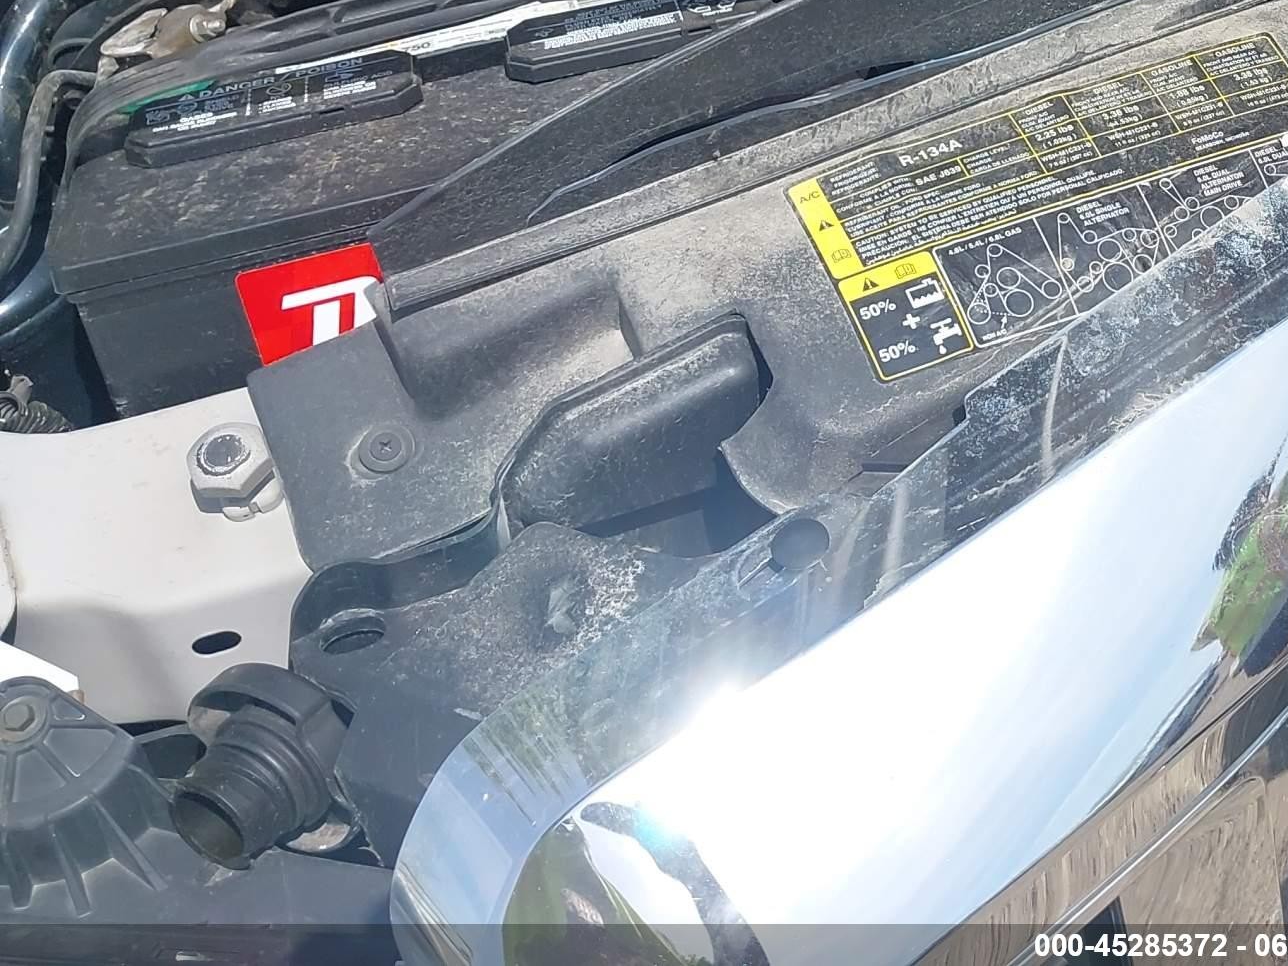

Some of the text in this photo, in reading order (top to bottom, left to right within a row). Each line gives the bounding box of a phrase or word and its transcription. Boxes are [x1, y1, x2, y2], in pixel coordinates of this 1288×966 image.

[1215, 42, 1254, 56] GASOLINE
[1151, 59, 1192, 76] GASOLINE
[1252, 67, 1268, 75] lbs
[199, 76, 274, 97] DANGER
[295, 58, 362, 76] POISON
[1093, 82, 1123, 94] DIESEL
[1189, 85, 1204, 93] lbs
[1025, 101, 1052, 115] DIESEL
[1122, 105, 1139, 113] lbs
[1035, 124, 1073, 140] 2.25 lbs
[1191, 131, 1223, 144] FoMoCo
[898, 139, 961, 165] R-134A
[1254, 146, 1277, 157] DIESEL
[915, 165, 961, 185] SAE J639
[1193, 164, 1217, 175] DIESEL
[1196, 169, 1229, 182] 6.0L DUAL
[1201, 171, 1243, 189] ALTERNATOR
[1203, 180, 1242, 196] MAIN DRIVE
[796, 190, 821, 203] A/C
[844, 208, 888, 226] REFRIGERANT
[905, 196, 922, 204] FORD
[889, 221, 916, 234] SYSTEM
[939, 203, 971, 217] SERVICED
[982, 188, 1016, 202] QUALIFIED
[921, 224, 950, 236] SISTEMA
[951, 217, 969, 227] DEBE
[985, 202, 1017, 215] ATENDIDO
[1051, 181, 1085, 194] PERSONAL
[1076, 201, 1101, 213] DIESEL
[1079, 202, 1120, 219] 6.0L SINGLE
[858, 243, 875, 252] MISE
[887, 230, 911, 241] GARDE
[927, 215, 956, 228] CONFIER
[1027, 180, 1065, 195] PERSONNEL
[1084, 207, 1129, 225] ALTERNATOR
[1004, 227, 1021, 236] GAS
[859, 299, 895, 319] 50%
[879, 340, 915, 361] 50%
